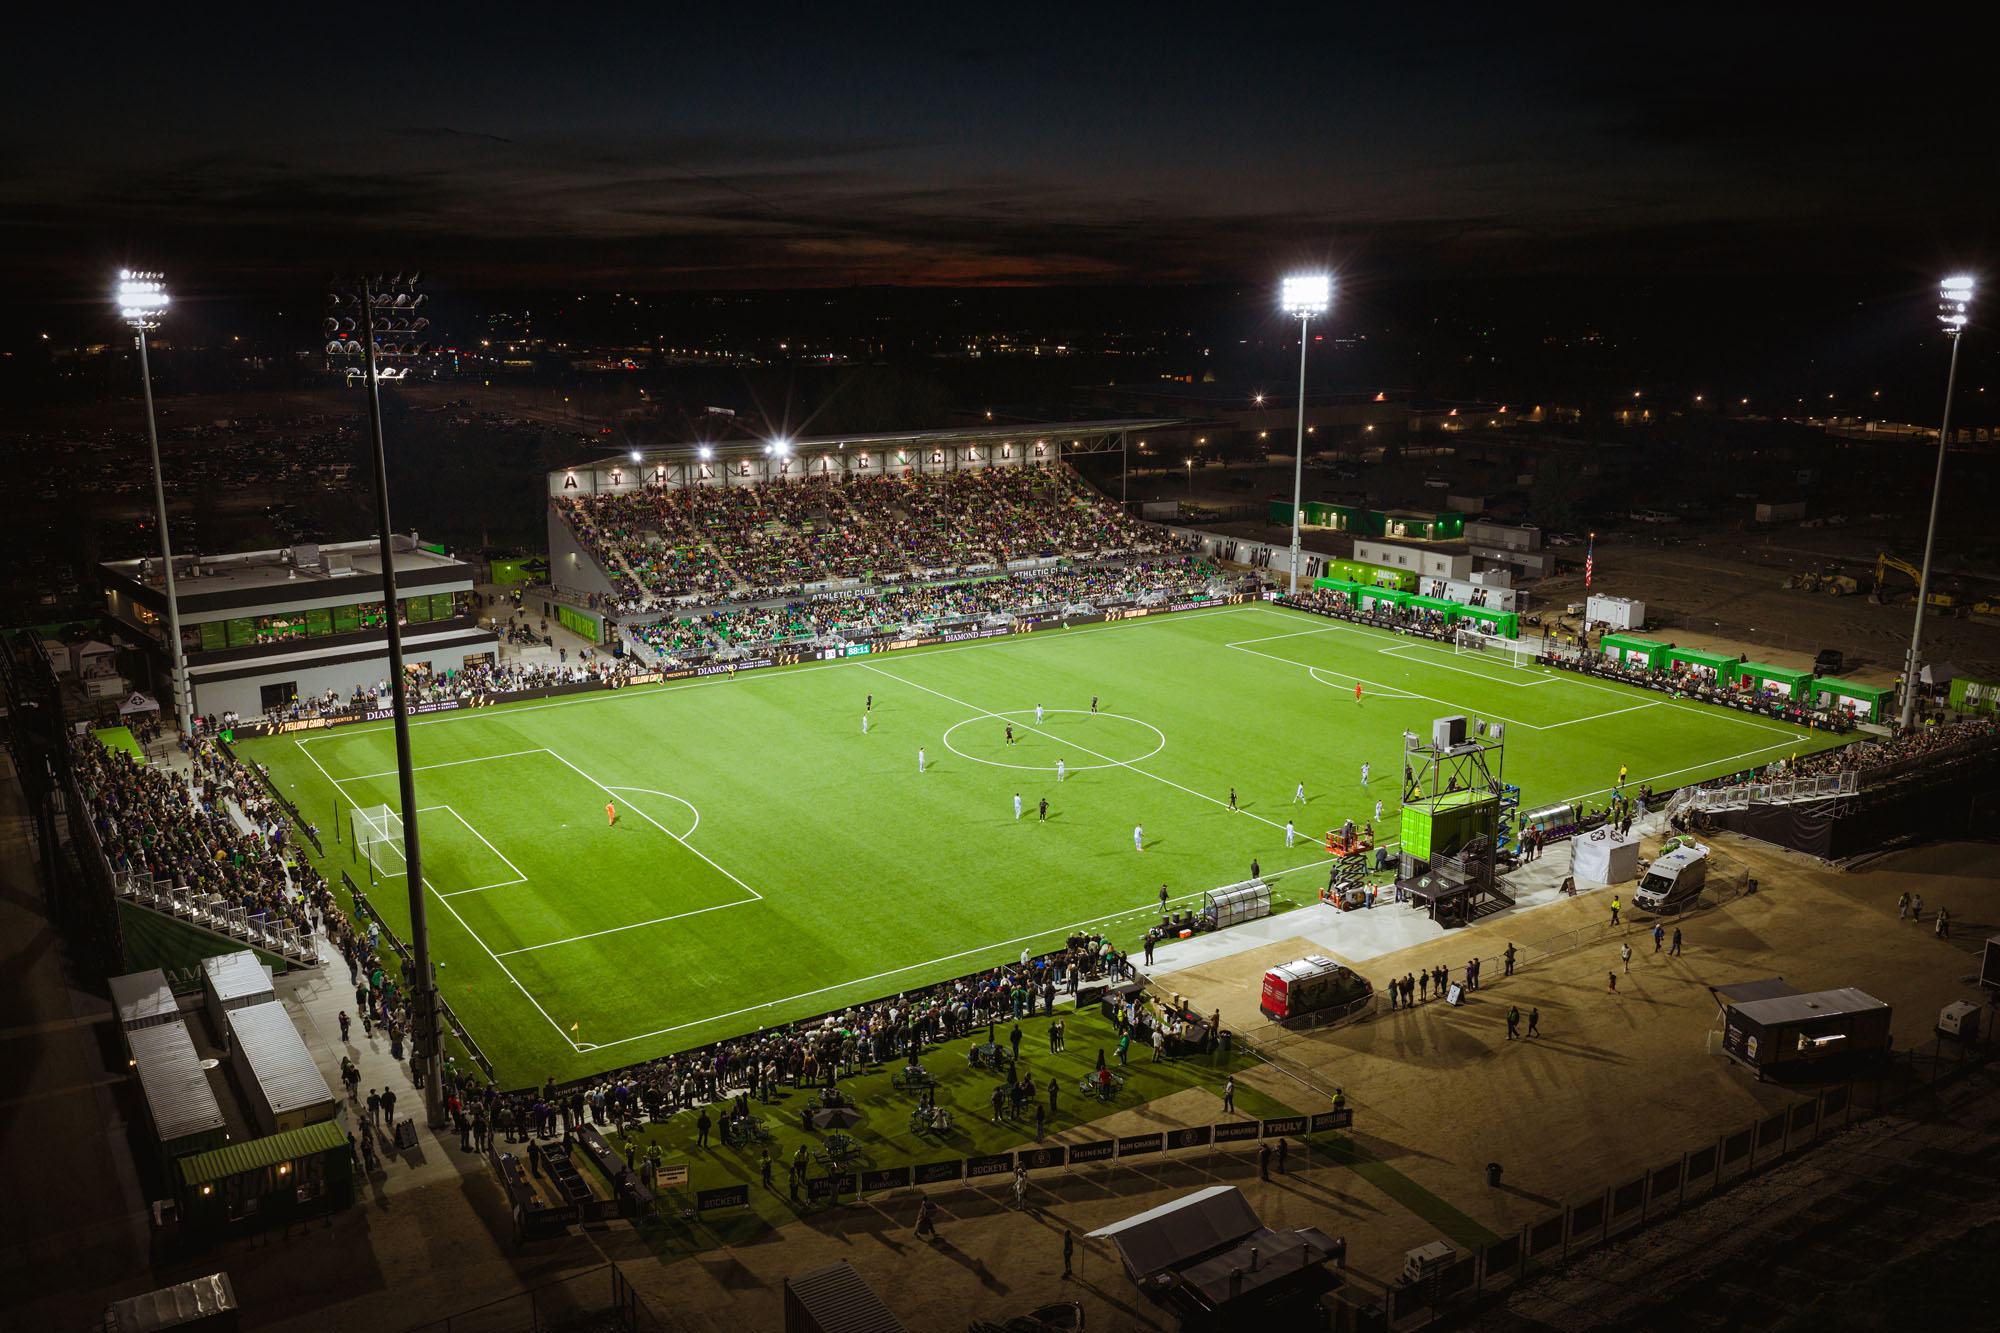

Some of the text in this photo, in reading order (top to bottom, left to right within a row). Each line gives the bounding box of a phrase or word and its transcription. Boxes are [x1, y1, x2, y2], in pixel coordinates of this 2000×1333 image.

[1014, 568, 1048, 577] ATHLETIC
[812, 588, 875, 600] ATHLETIC CLUB
[1170, 602, 1199, 612] DIAMOND
[945, 631, 979, 642] DIAMOND
[697, 664, 737, 675] DIAMOND
[630, 675, 650, 685] YELLOW
[367, 707, 416, 720] DIAMD
[285, 720, 309, 731] YELLOW
[309, 718, 326, 728] CARD
[1266, 1120, 1303, 1134] TRULY
[972, 1162, 1009, 1176] SOCKEYE
[704, 1194, 745, 1210] SOCKEYE
